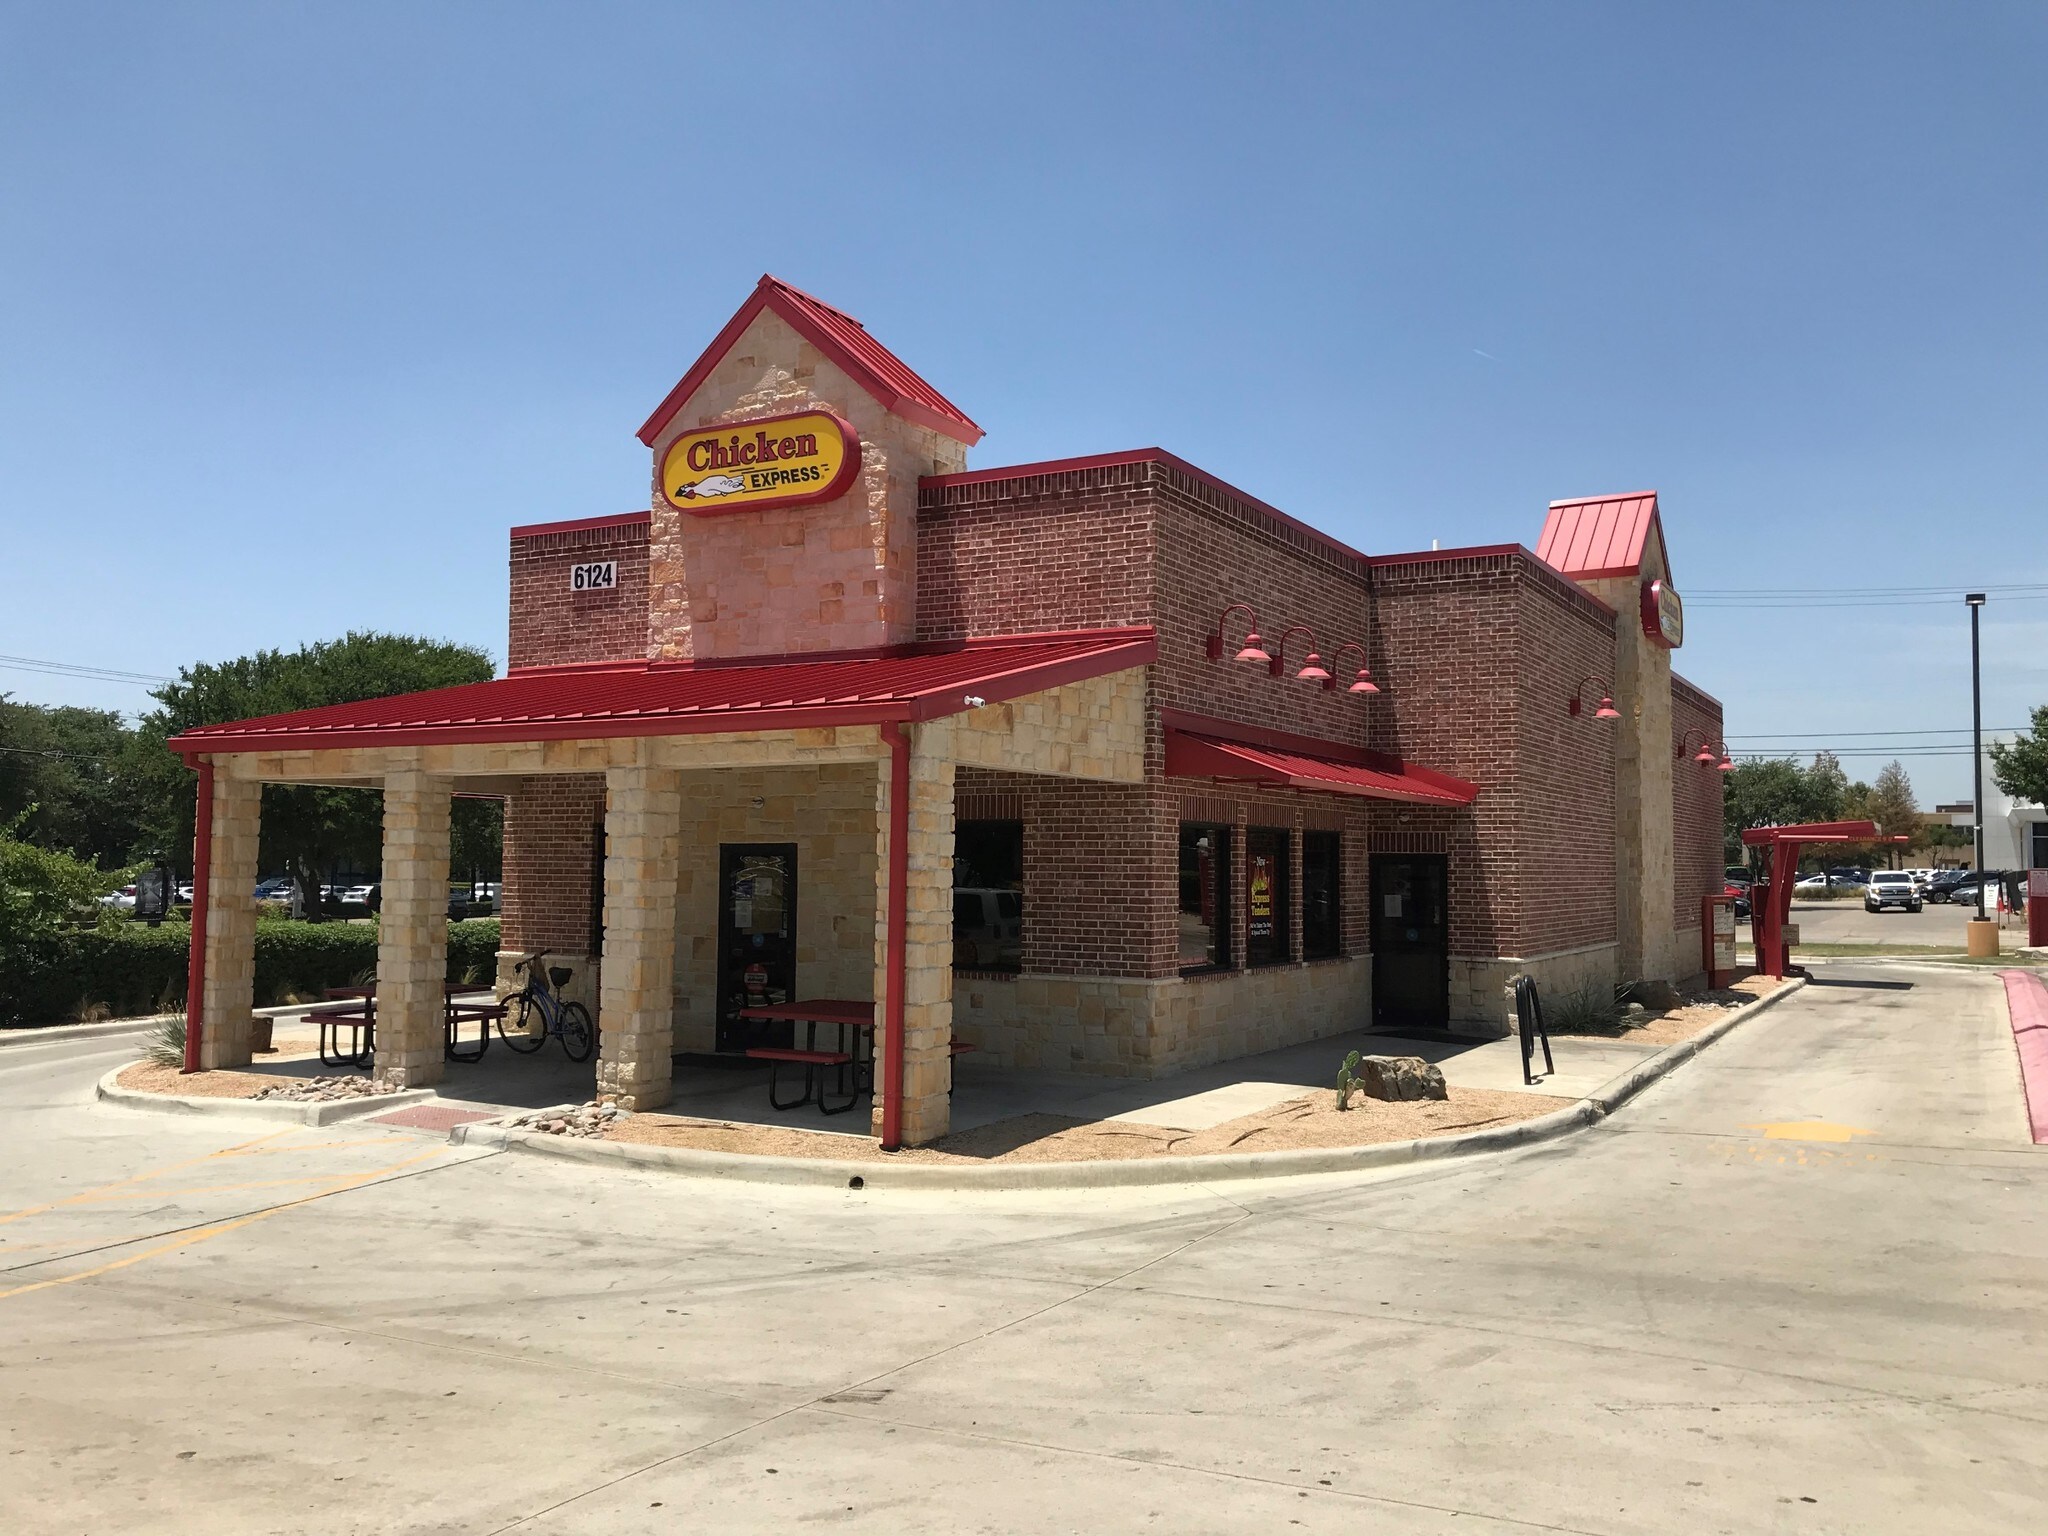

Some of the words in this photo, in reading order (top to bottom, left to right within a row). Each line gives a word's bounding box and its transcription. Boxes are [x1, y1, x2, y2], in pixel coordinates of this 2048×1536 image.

[687, 431, 818, 472] Chicken
[751, 466, 821, 488] EXPRESS
[573, 563, 613, 590] 6124
[1251, 905, 1270, 916] Tenders
